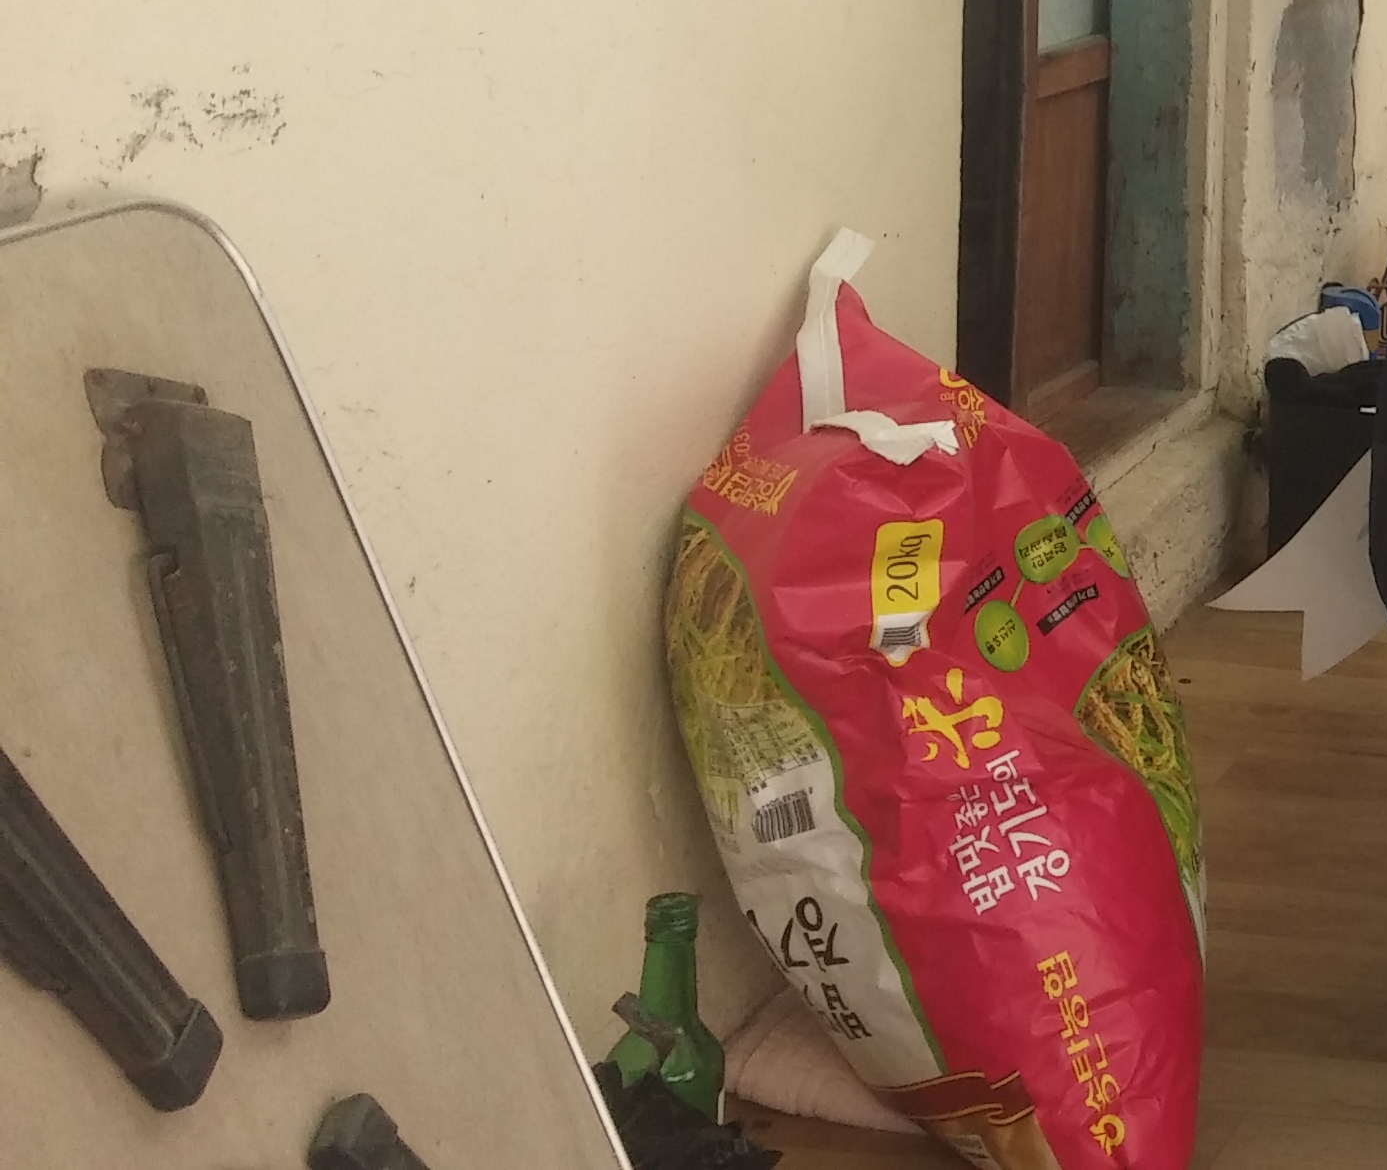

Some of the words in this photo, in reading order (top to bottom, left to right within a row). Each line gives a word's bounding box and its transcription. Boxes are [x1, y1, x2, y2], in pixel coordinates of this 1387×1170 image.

[886, 533, 932, 602] 20kg
[949, 825, 1016, 916] 밥맛
[985, 749, 1070, 902] 경기도의
[1037, 950, 1121, 1114] 송탄농협
